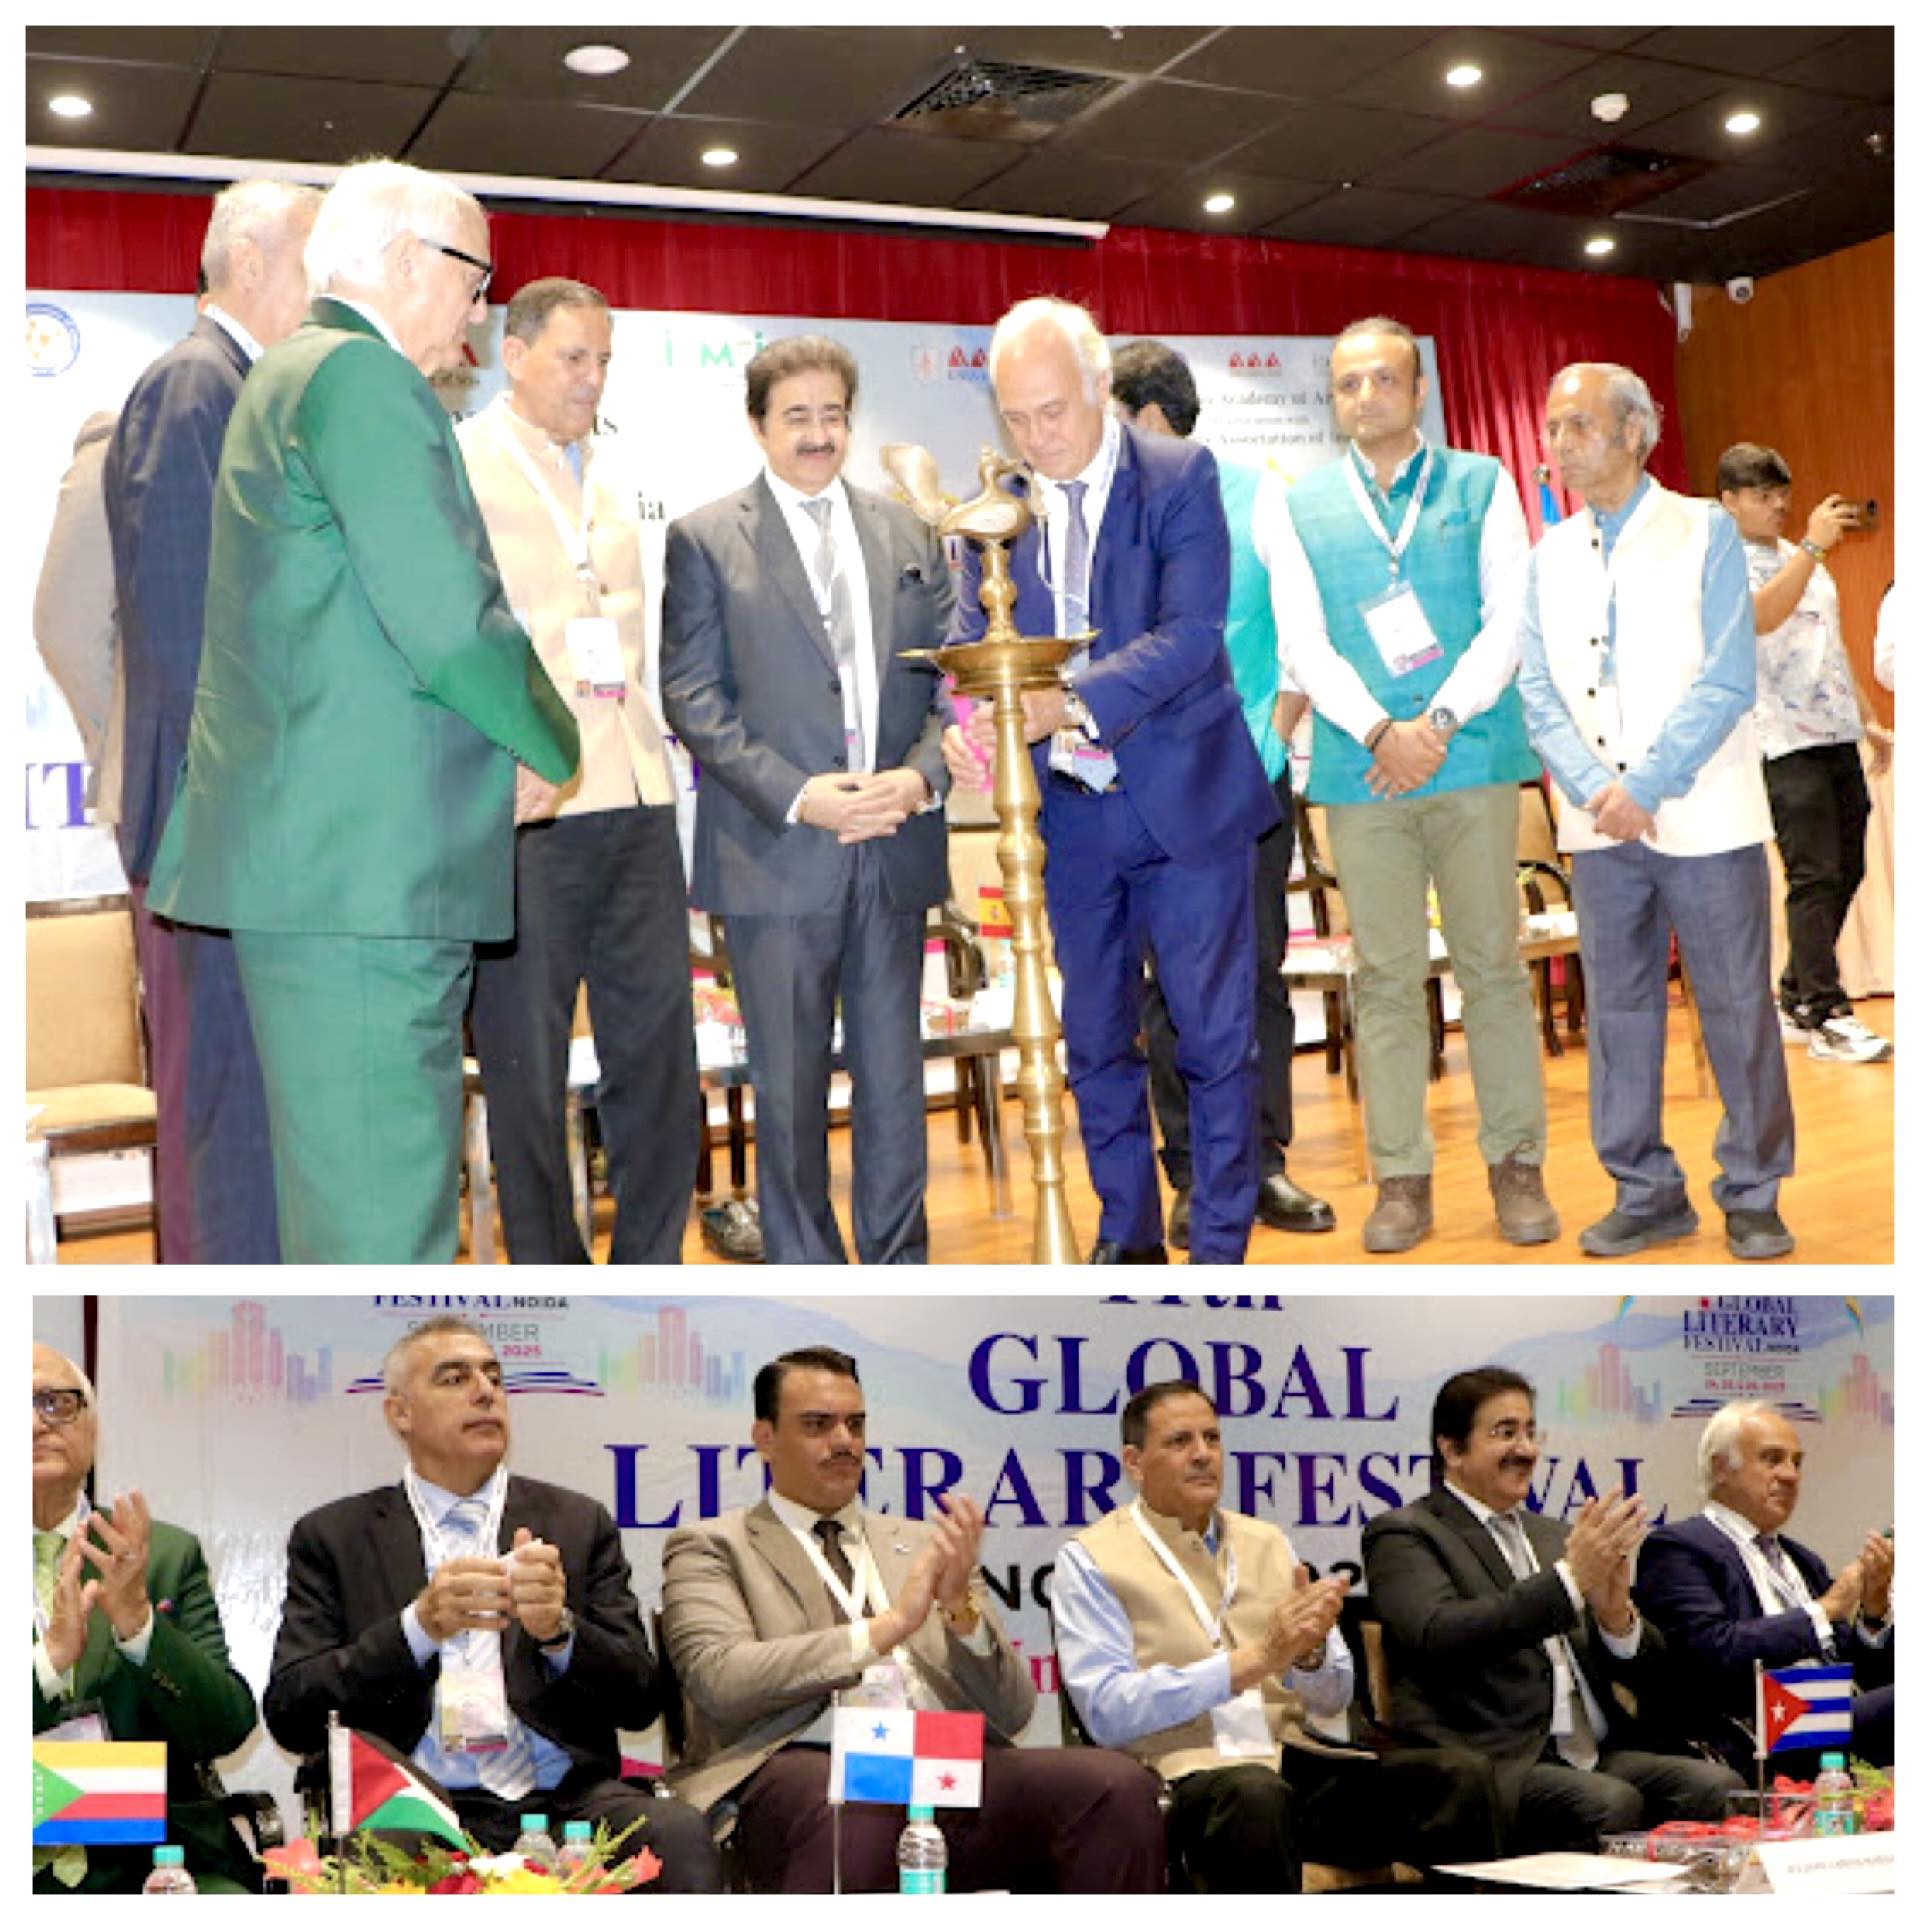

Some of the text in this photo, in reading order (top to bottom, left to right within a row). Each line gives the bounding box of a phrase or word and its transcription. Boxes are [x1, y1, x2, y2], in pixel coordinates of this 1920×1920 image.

[513, 1296, 569, 1308] NOIDA
[1684, 1310, 1798, 1338] LITERARY
[502, 1344, 543, 1358] 2025
[1684, 1334, 1762, 1352] FESTIVAL
[969, 1331, 1400, 1422] GLOBAL
[604, 1444, 1669, 1528] LIRAR FESVAL
